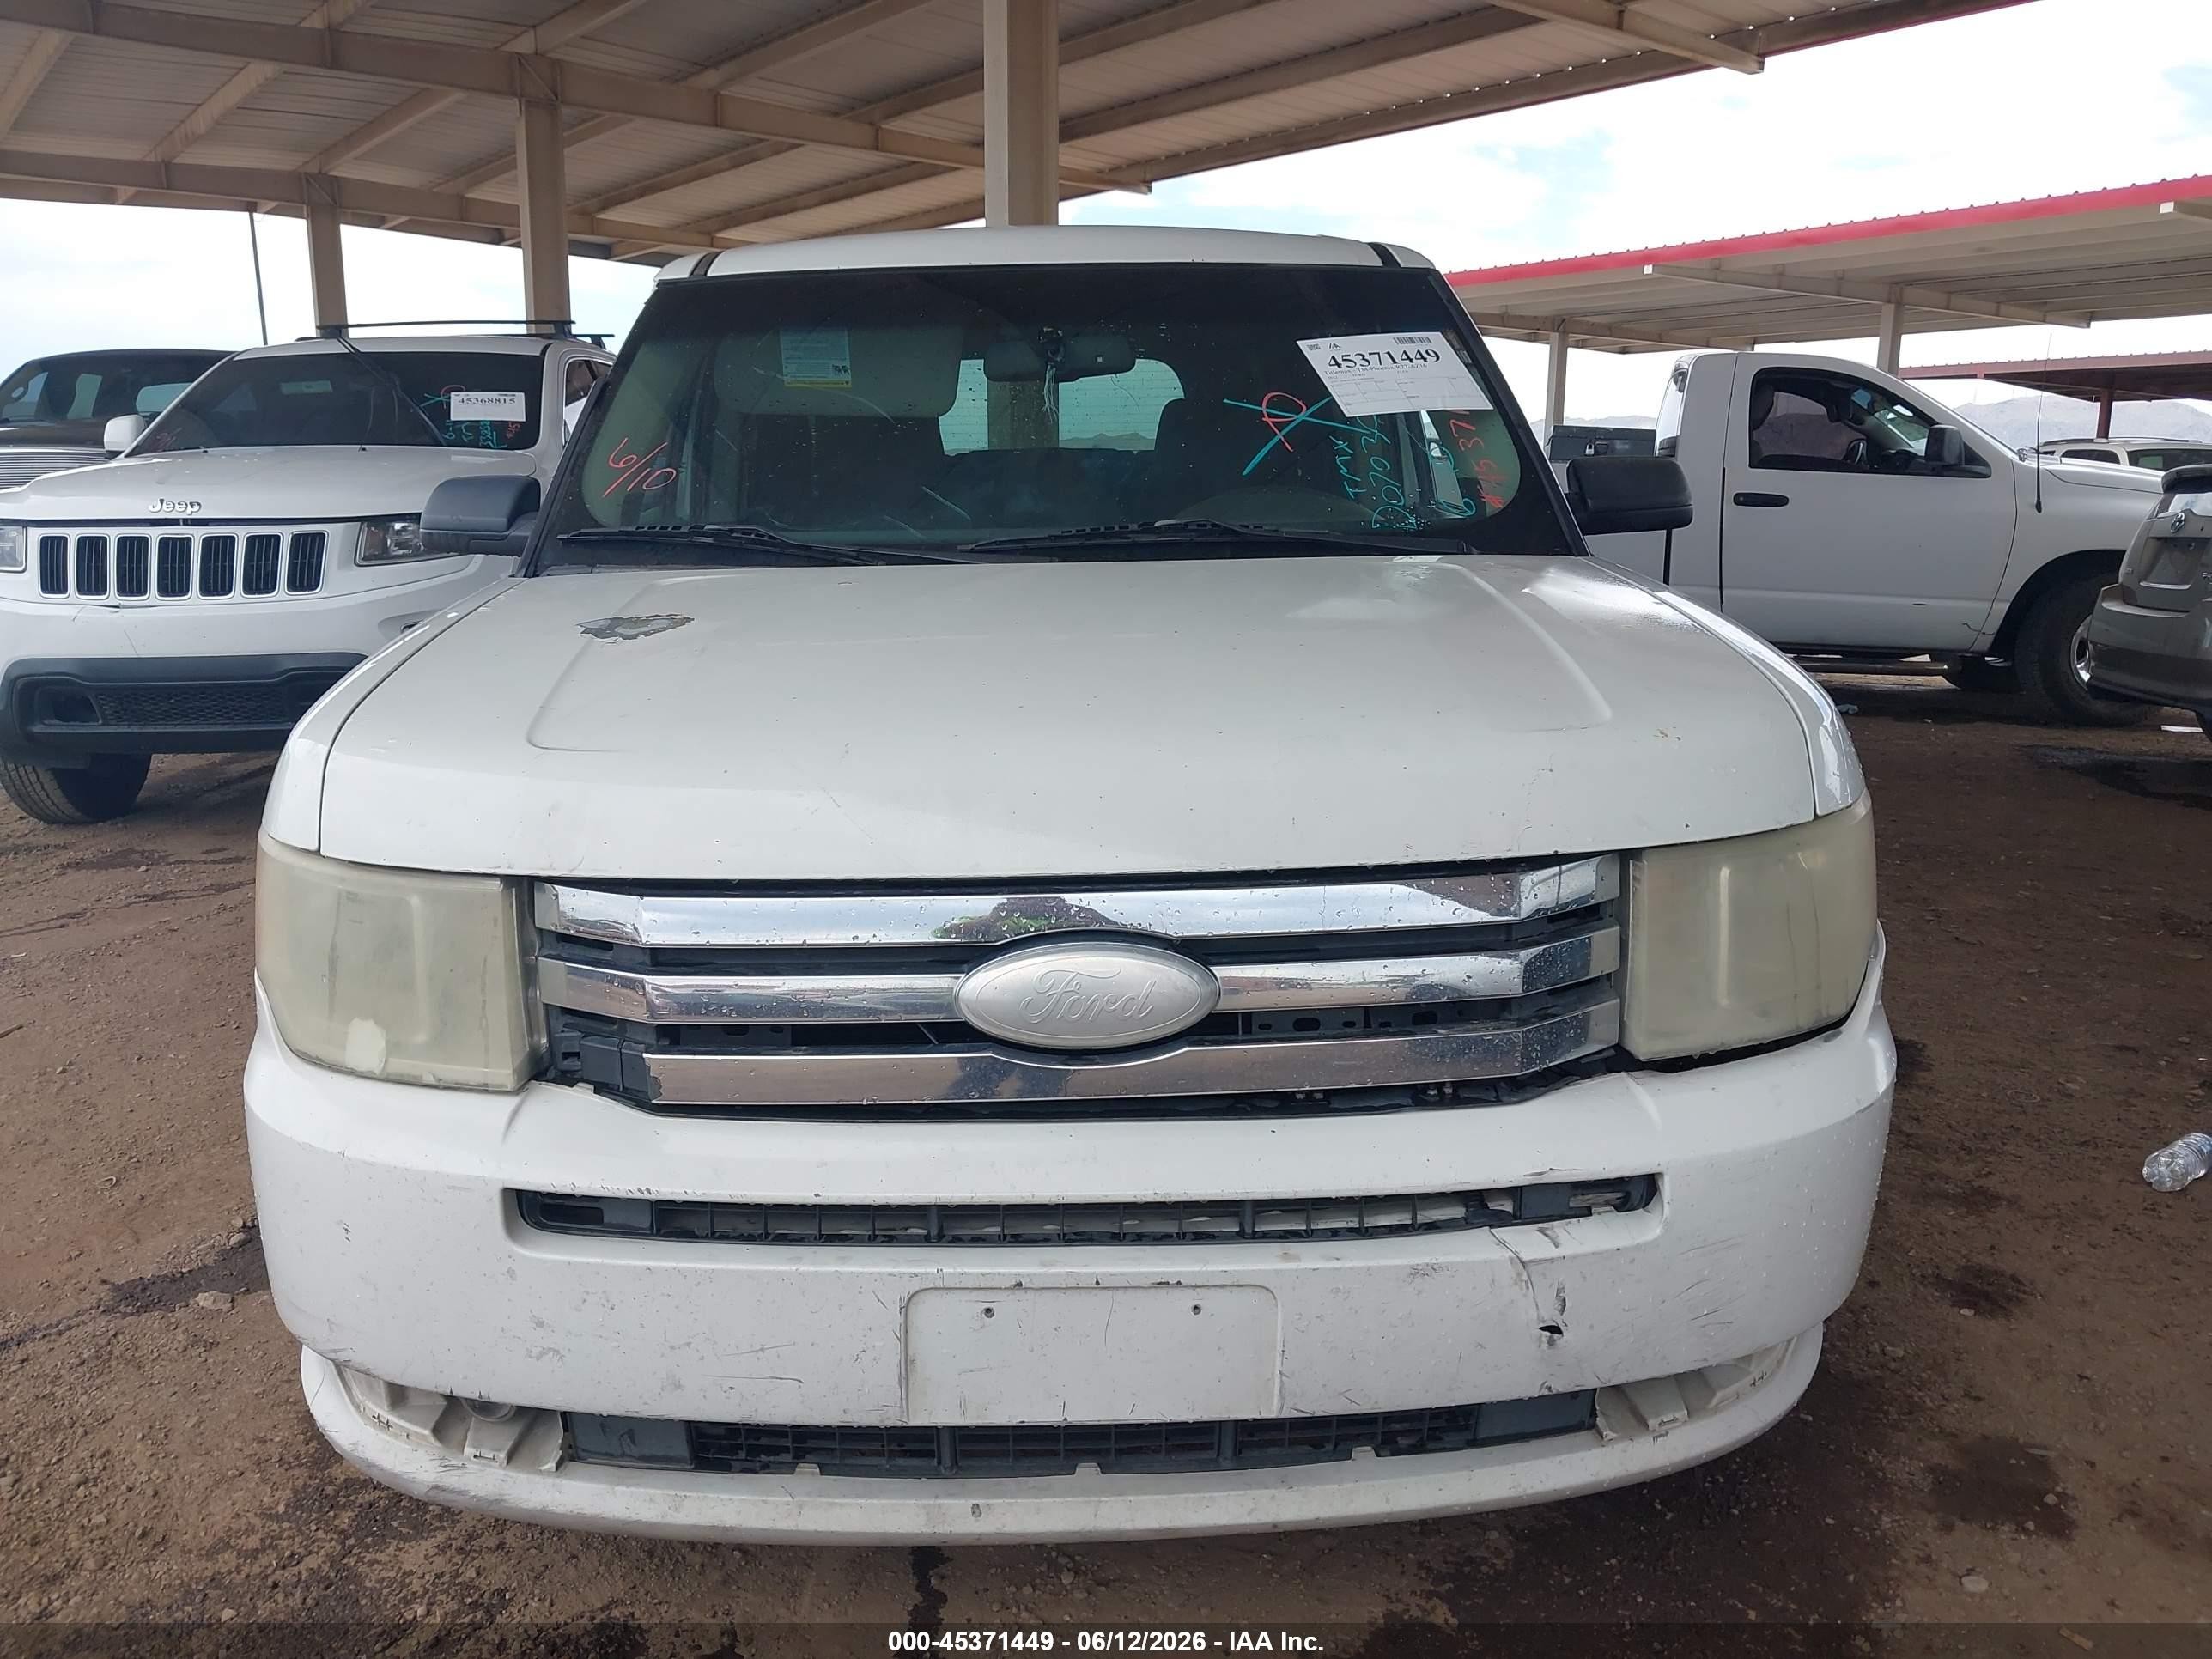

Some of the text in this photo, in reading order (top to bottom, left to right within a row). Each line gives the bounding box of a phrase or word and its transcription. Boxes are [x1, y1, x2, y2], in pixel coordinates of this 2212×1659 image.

[1328, 349, 1440, 368] 45371449
[602, 437, 677, 498] 6/10
[149, 497, 203, 516] Jeep
[1019, 967, 1158, 1024] Ford
